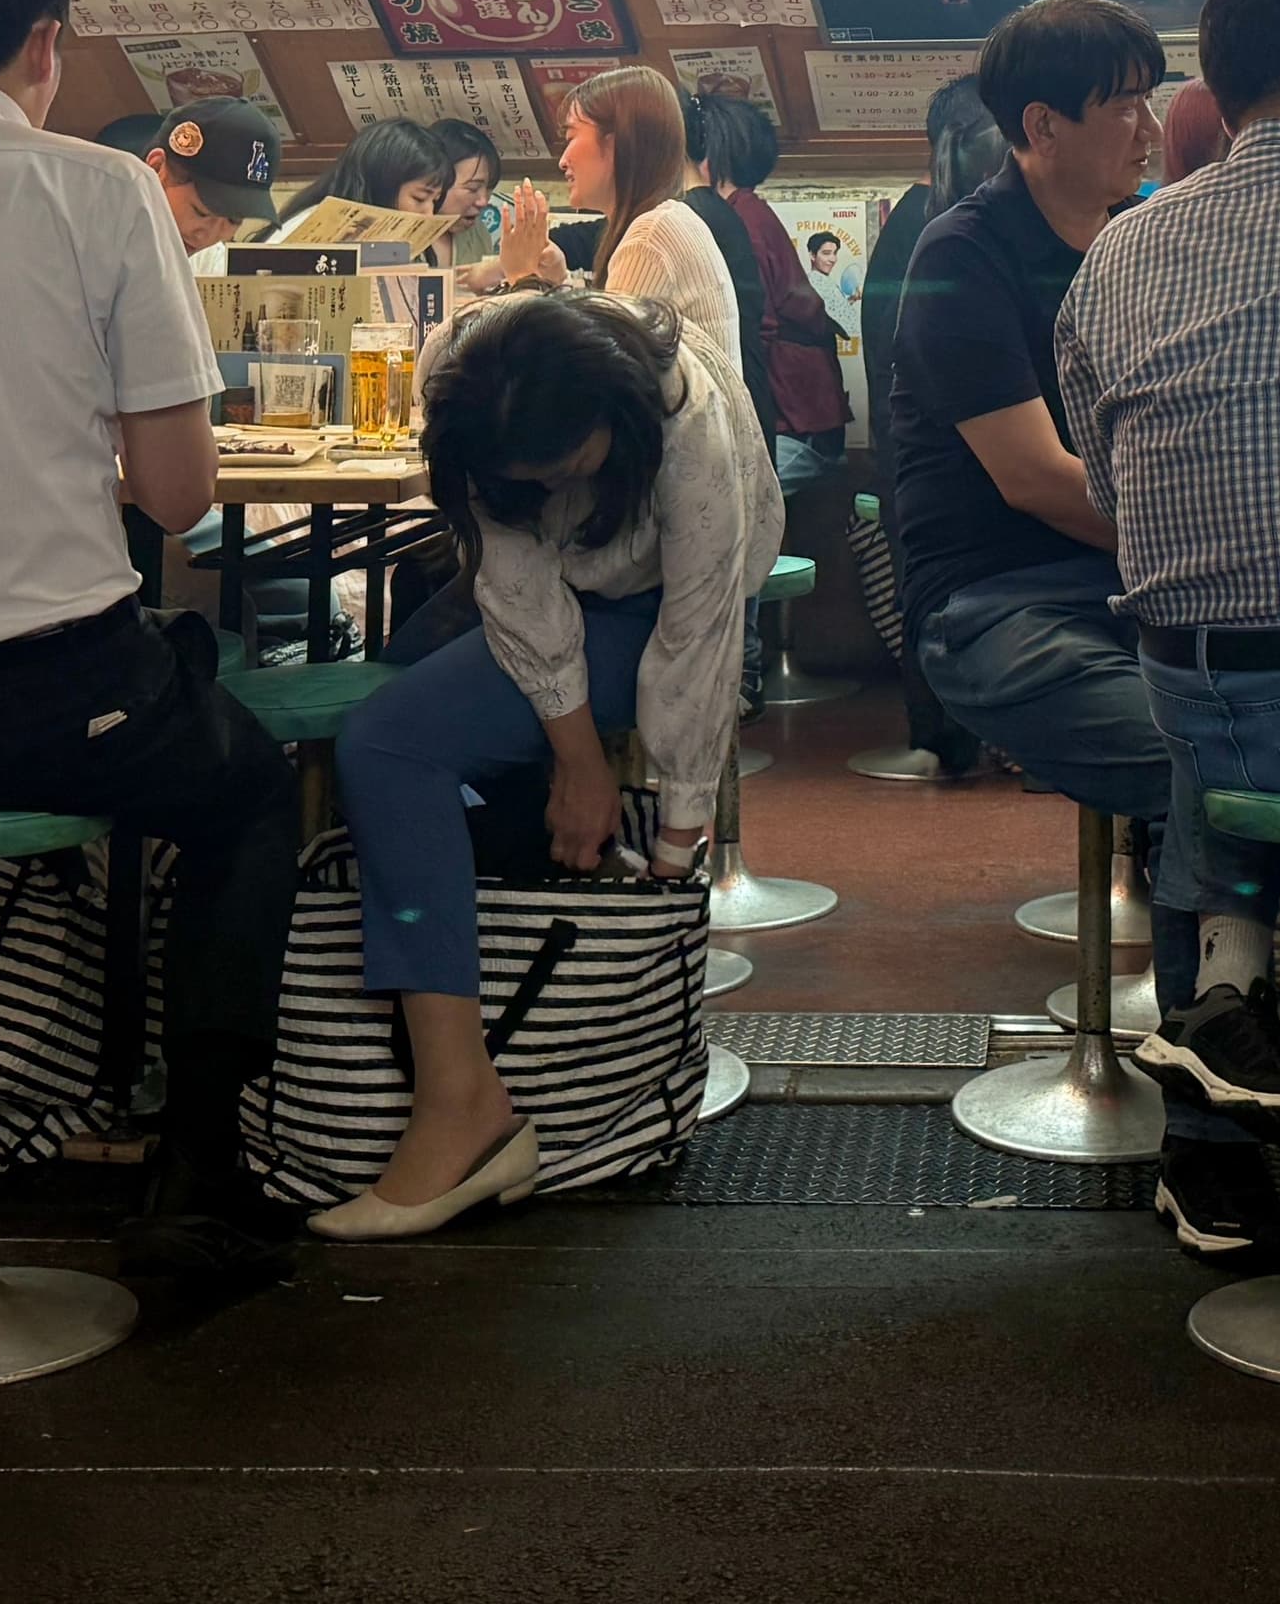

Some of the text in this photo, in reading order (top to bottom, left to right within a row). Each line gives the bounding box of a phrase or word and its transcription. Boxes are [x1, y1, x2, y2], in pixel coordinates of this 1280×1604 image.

[341, 64, 365, 97] 梅干し
[379, 63, 403, 97] 麦焼酎
[416, 62, 440, 97] 芋焼酎
[832, 210, 857, 219] KIRIN
